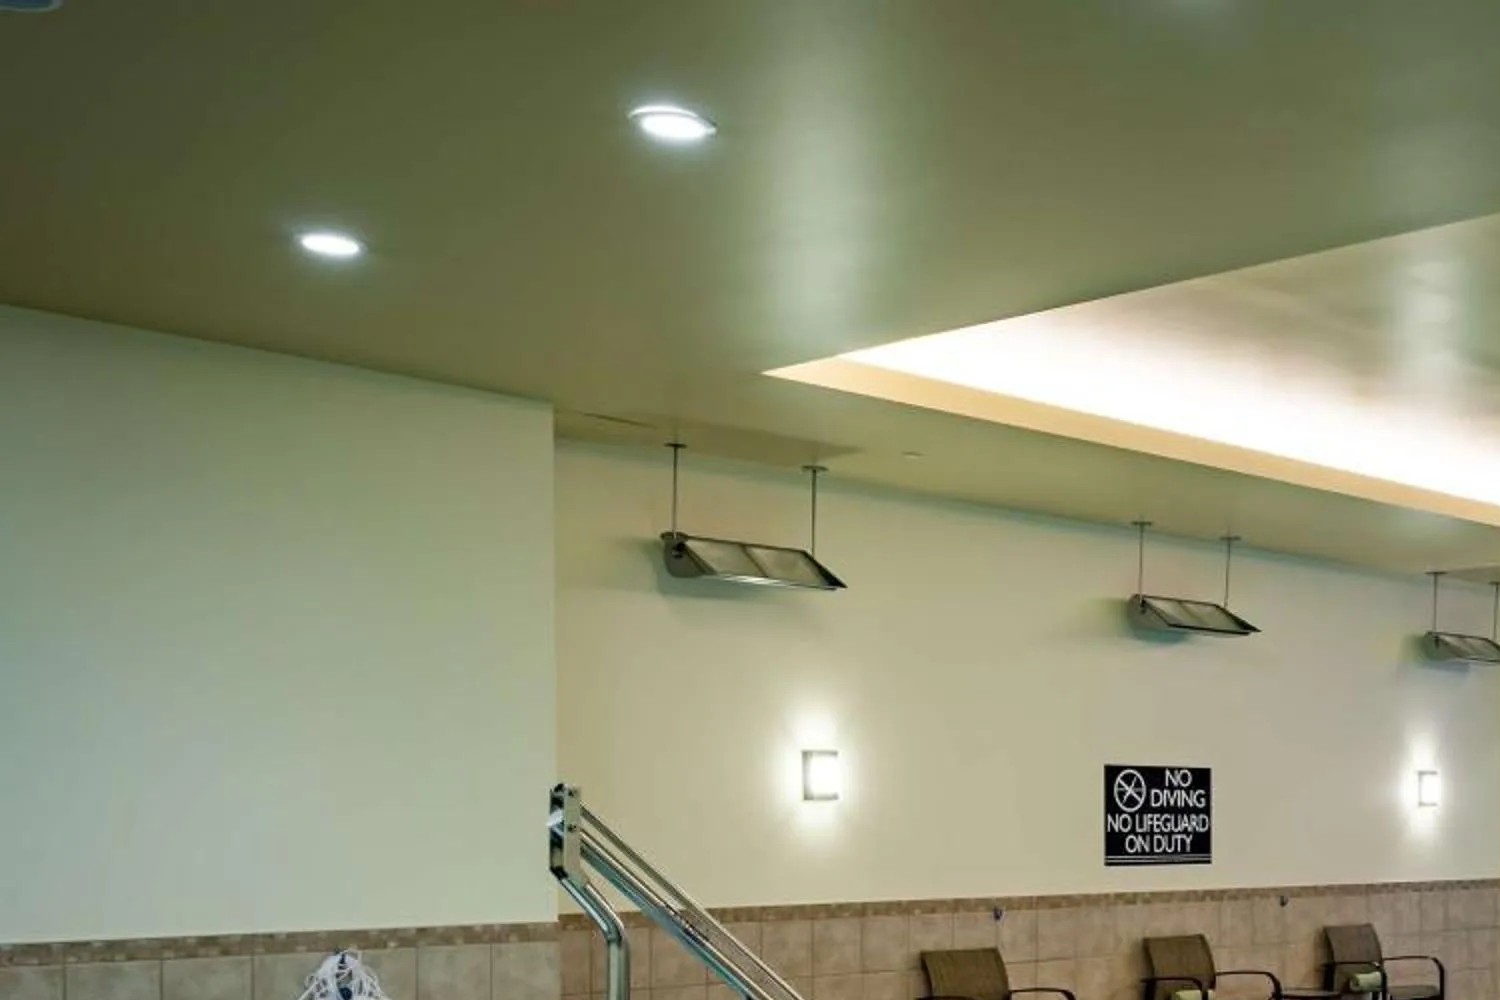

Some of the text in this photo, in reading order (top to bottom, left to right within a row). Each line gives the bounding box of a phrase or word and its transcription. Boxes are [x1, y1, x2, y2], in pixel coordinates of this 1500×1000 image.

[1165, 768, 1192, 787] NO
[1151, 789, 1206, 808] DIVING
[1107, 813, 1209, 833] NO LIFEGUARD
[1125, 834, 1193, 853] ON DUTY
